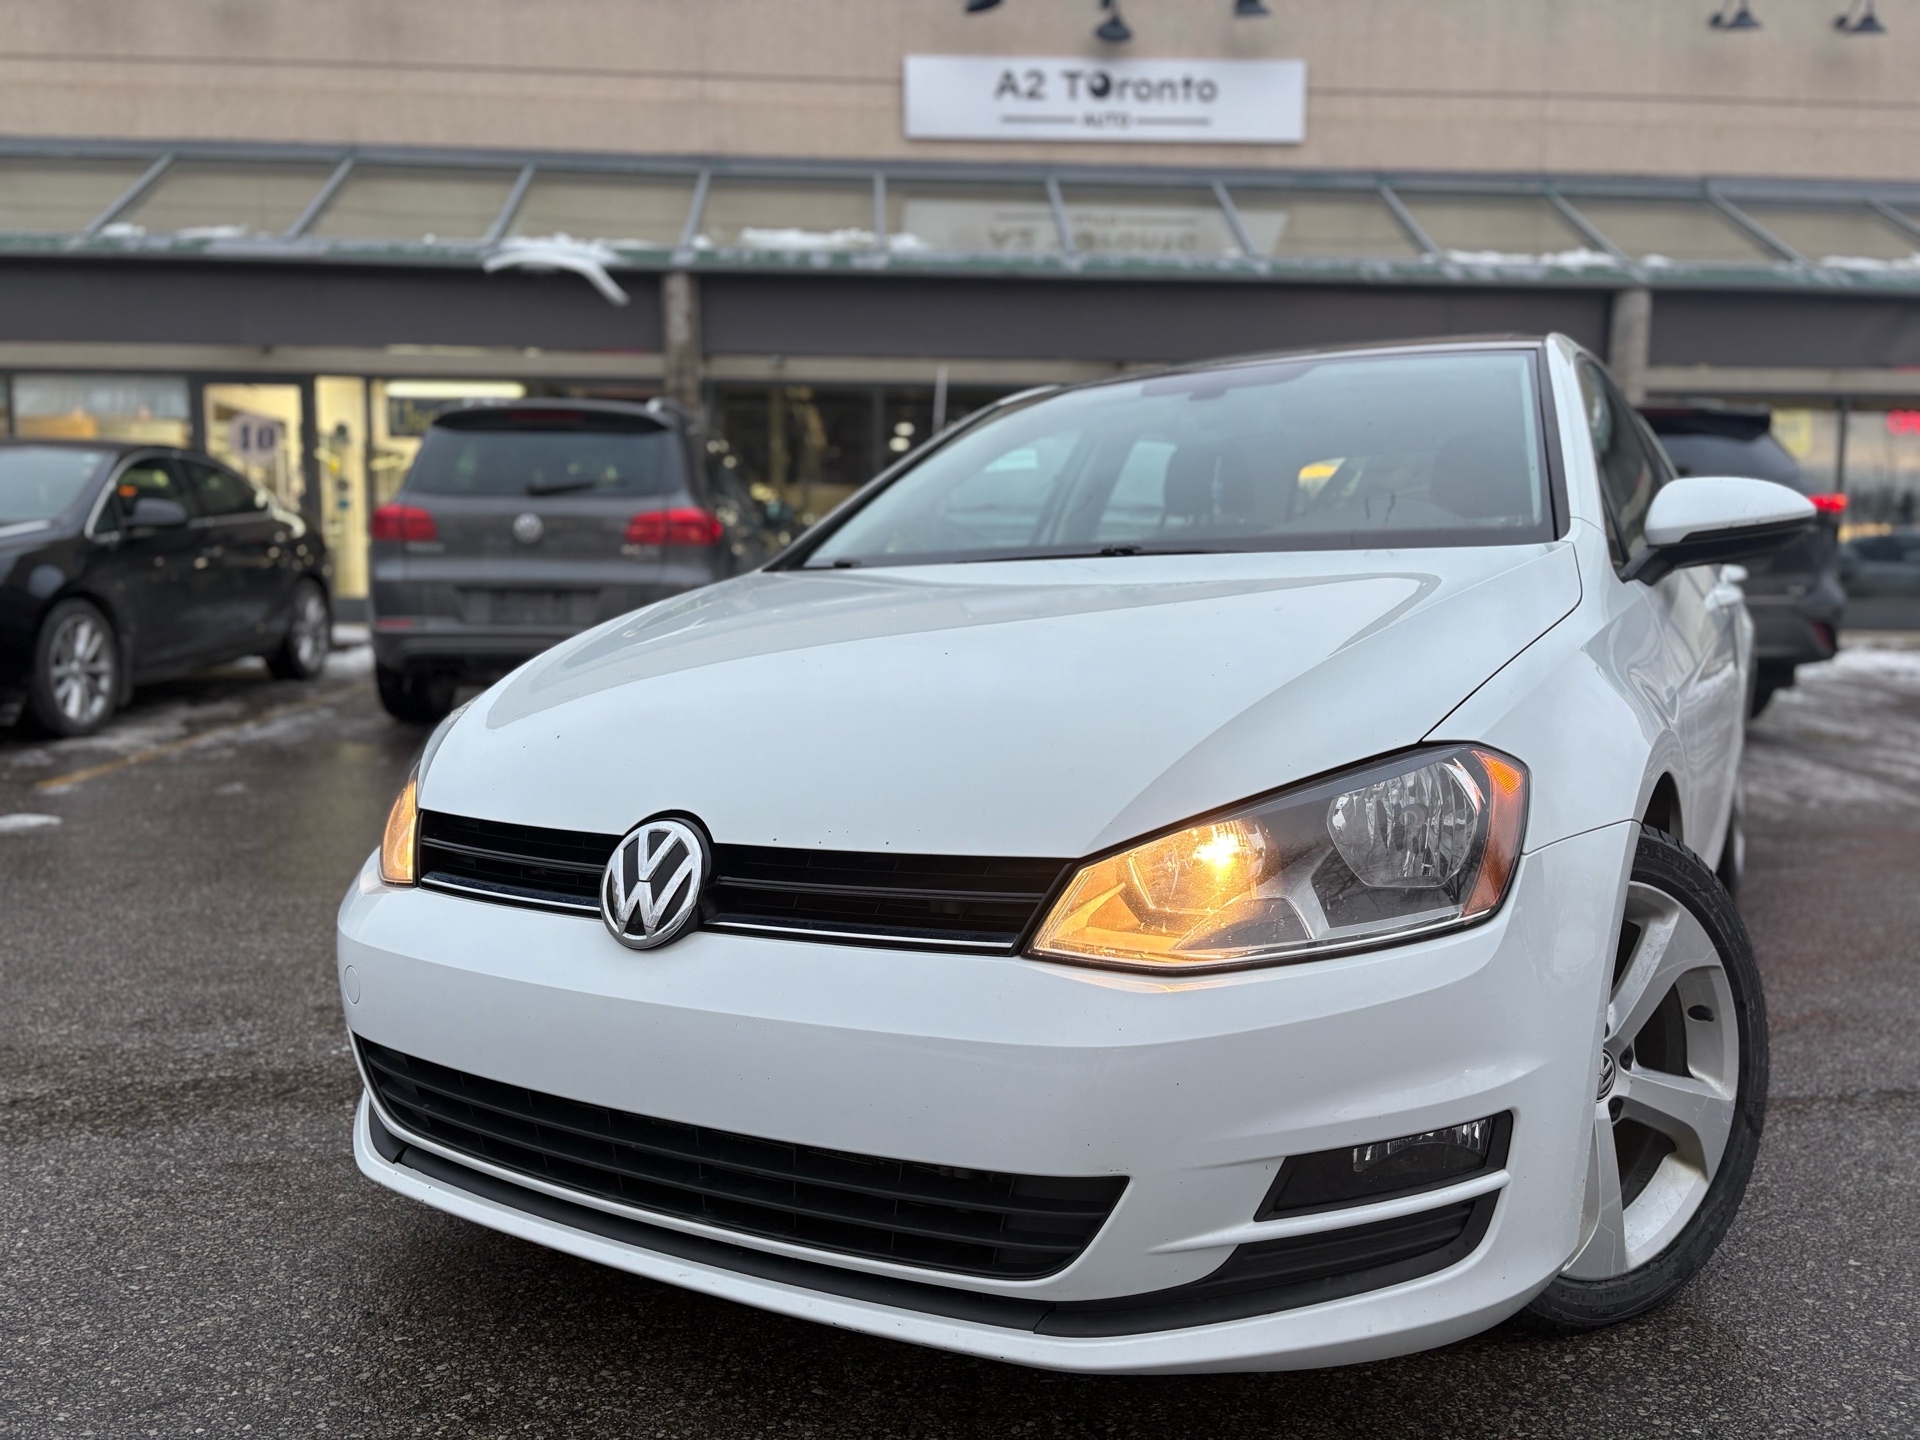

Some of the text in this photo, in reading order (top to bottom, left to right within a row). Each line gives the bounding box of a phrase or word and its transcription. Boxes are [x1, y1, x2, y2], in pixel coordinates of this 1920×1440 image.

[996, 69, 1047, 100] A2
[1082, 111, 1132, 129] AUTO
[240, 424, 276, 451] 10
